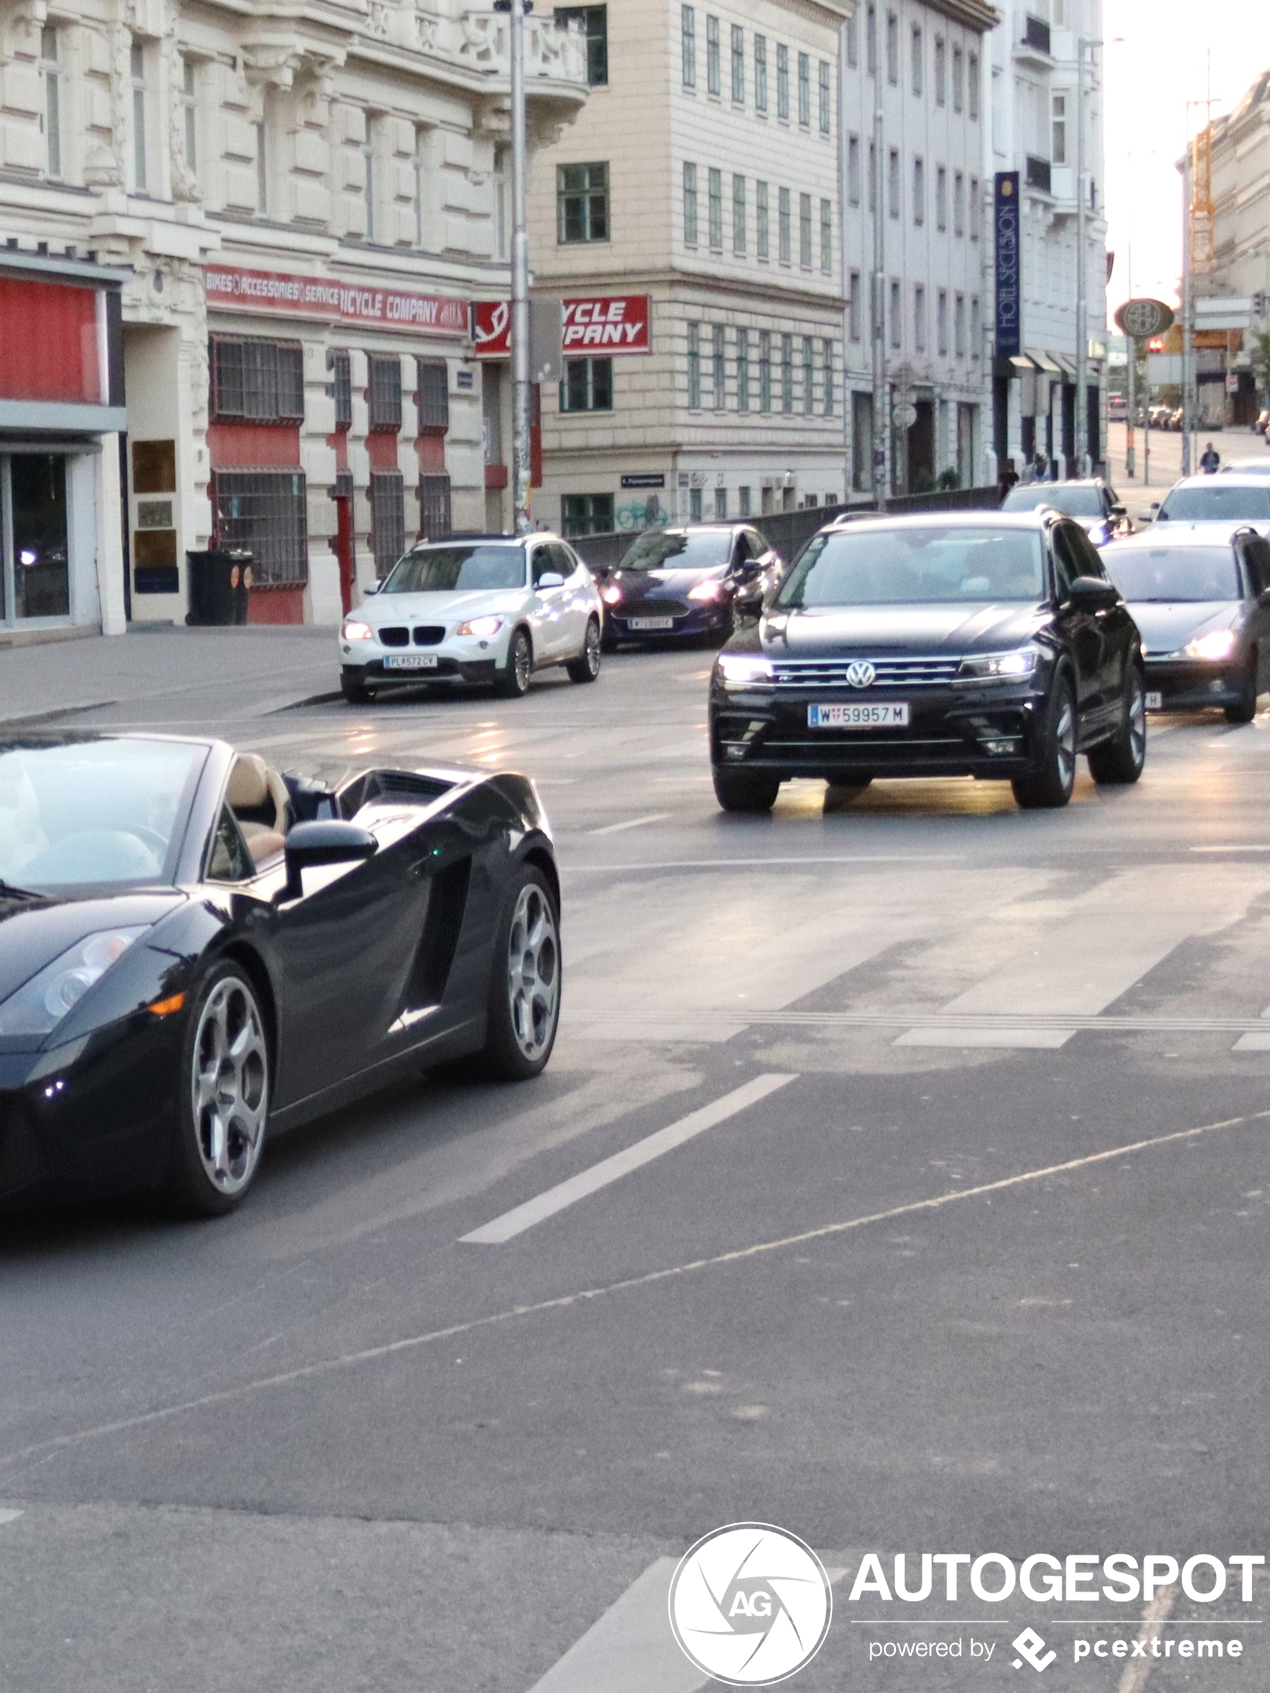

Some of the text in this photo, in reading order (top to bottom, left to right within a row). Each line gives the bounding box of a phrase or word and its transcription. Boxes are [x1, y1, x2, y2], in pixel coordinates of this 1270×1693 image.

[998, 205, 1016, 284] SECESSION
[206, 273, 339, 305] BIKES ACCESSORIES SERVICE
[386, 295, 439, 324] COMPANY
[562, 302, 627, 324] YCLE
[999, 286, 1016, 327] HOTEL
[562, 322, 644, 346] PANY
[820, 708, 831, 723] W
